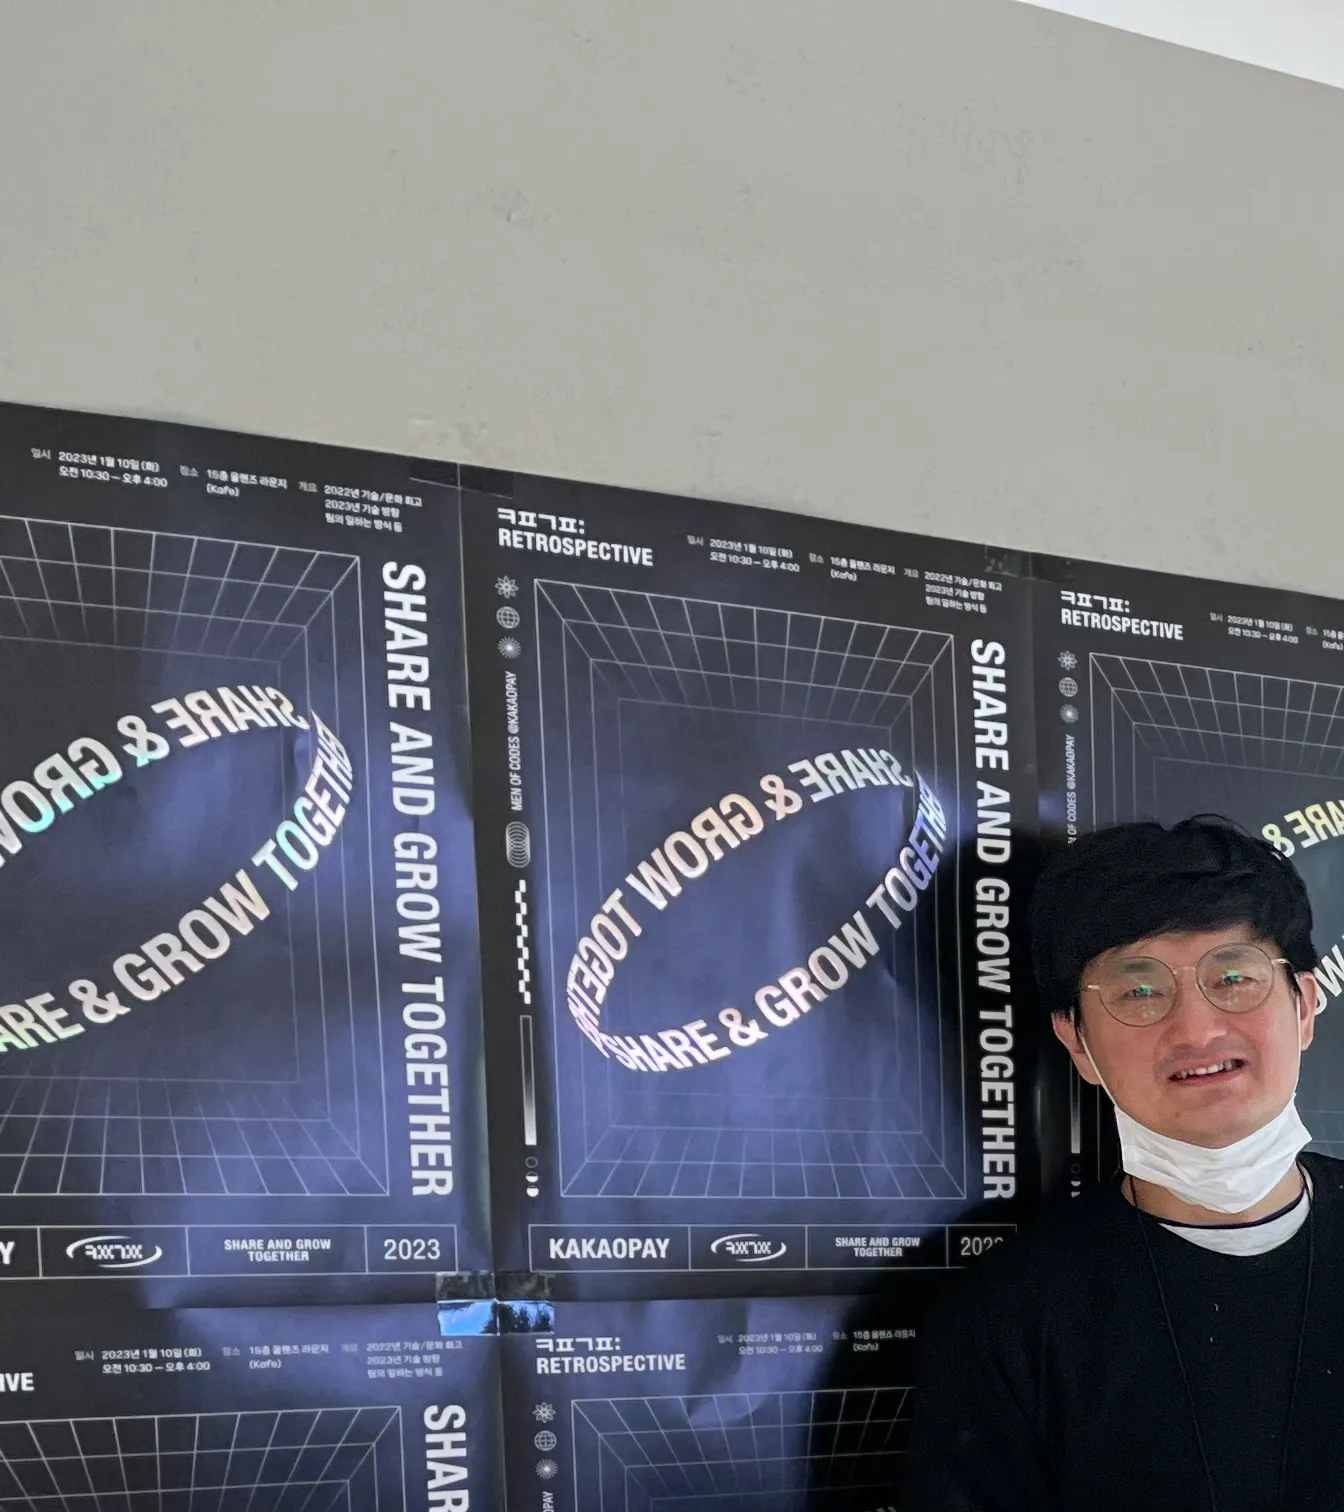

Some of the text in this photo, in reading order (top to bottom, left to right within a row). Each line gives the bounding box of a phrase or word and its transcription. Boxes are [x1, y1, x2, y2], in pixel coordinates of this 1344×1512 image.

[57, 451, 98, 466] 2023년
[324, 484, 359, 498] 2022년
[324, 499, 359, 513] 2023년
[498, 526, 653, 567] RETROSPECTIVE
[1062, 607, 1182, 641] RETROSPECTIVE
[508, 735, 521, 771] CODES
[510, 771, 521, 786] OF
[510, 787, 522, 811] MEN
[380, 561, 453, 1197] SHARE AND GROW TOGETHER
[970, 638, 1016, 1199] SHARE AND GROW TOGETHER
[68, 979, 132, 1023] &
[113, 869, 269, 1000] GROW
[599, 1019, 731, 1071] SHARE
[718, 1007, 768, 1046] &
[755, 911, 880, 1026] GROW
[224, 1239, 332, 1251] SHARE AND GROW
[382, 1238, 441, 1260] 2023
[548, 1238, 670, 1259] KAKAOPAY
[835, 1237, 920, 1247] SHARE AND GROW
[853, 1247, 902, 1257] TOGETHER
[247, 1251, 310, 1262] TOGETHER
[538, 1353, 685, 1374] RETROSPECTIVE
